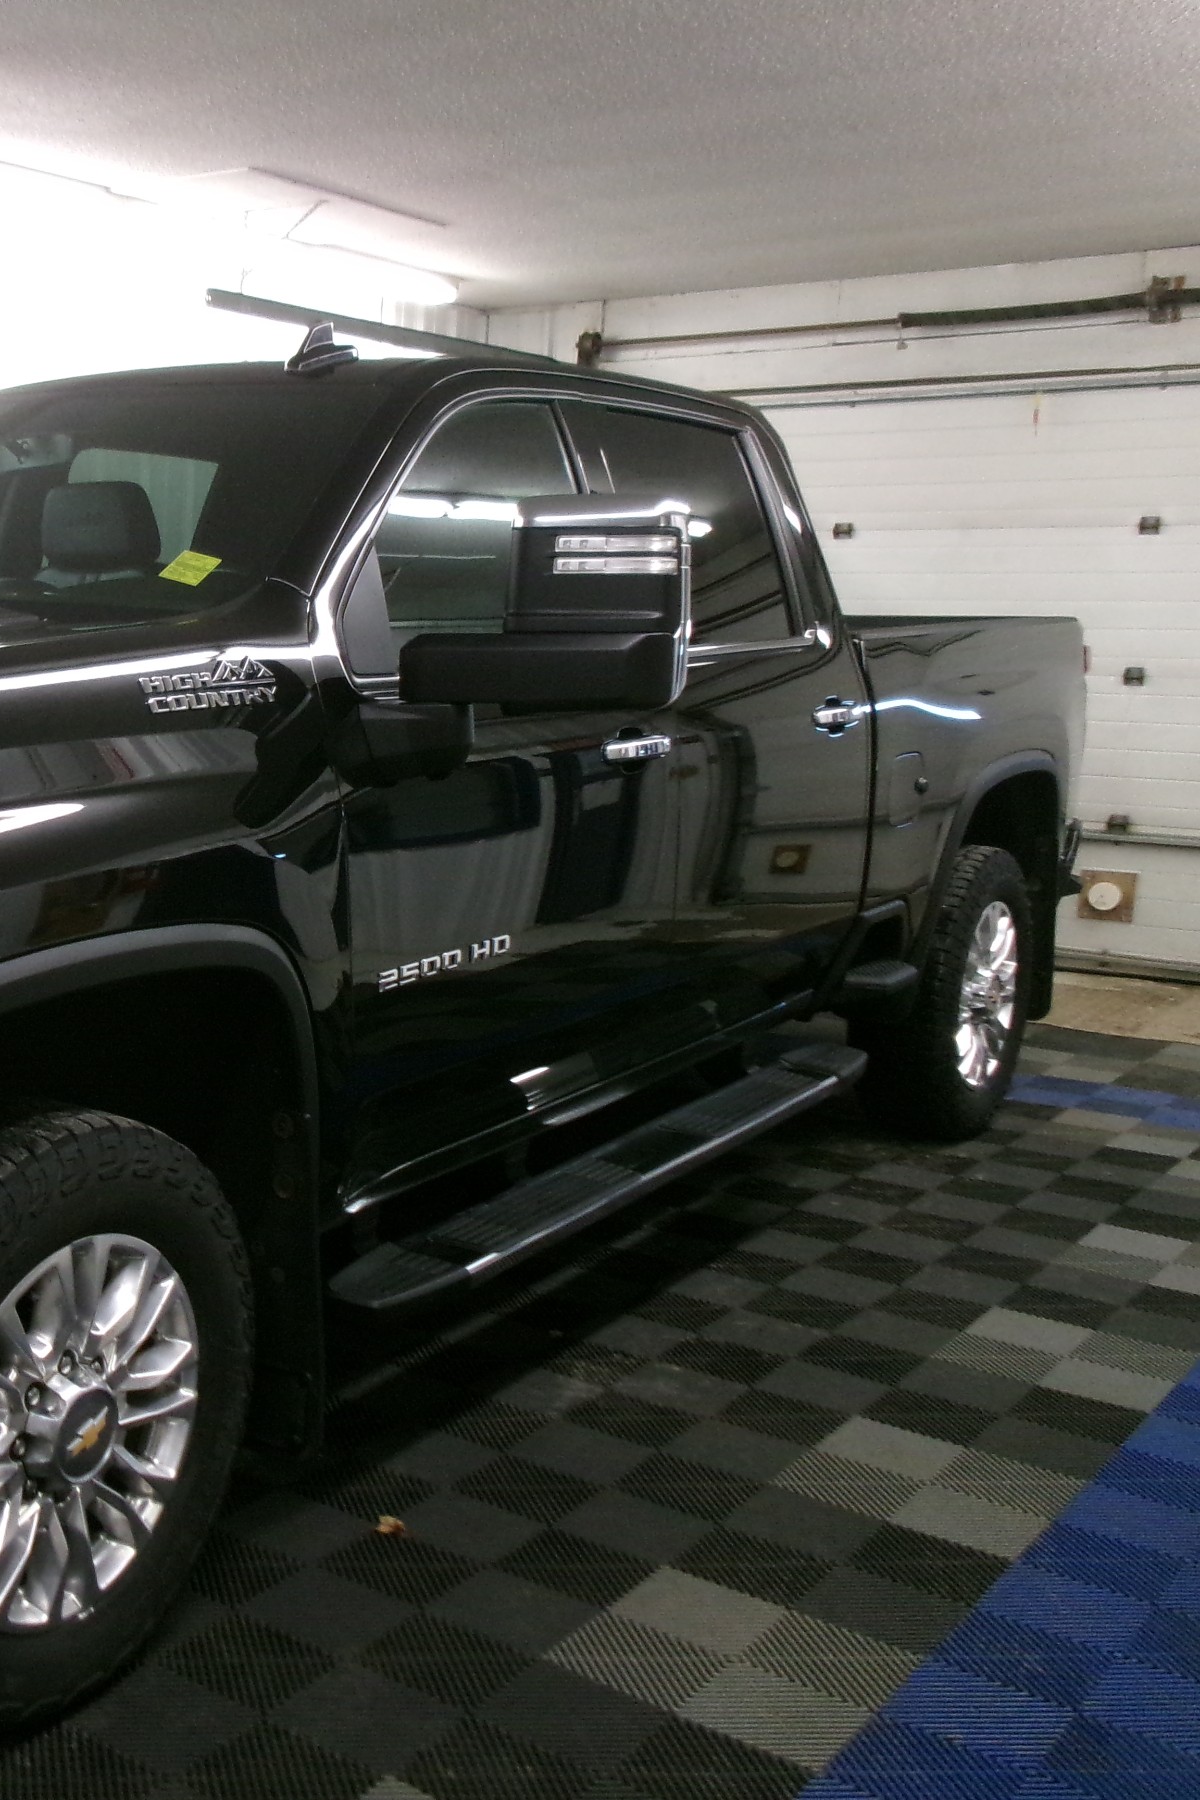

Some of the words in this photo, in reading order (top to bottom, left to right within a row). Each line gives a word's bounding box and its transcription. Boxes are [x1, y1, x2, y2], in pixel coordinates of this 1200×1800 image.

[138, 671, 214, 694] HIGH
[146, 685, 277, 714] COUNTRY
[378, 948, 462, 993] 2500
[469, 934, 511, 963] HD
